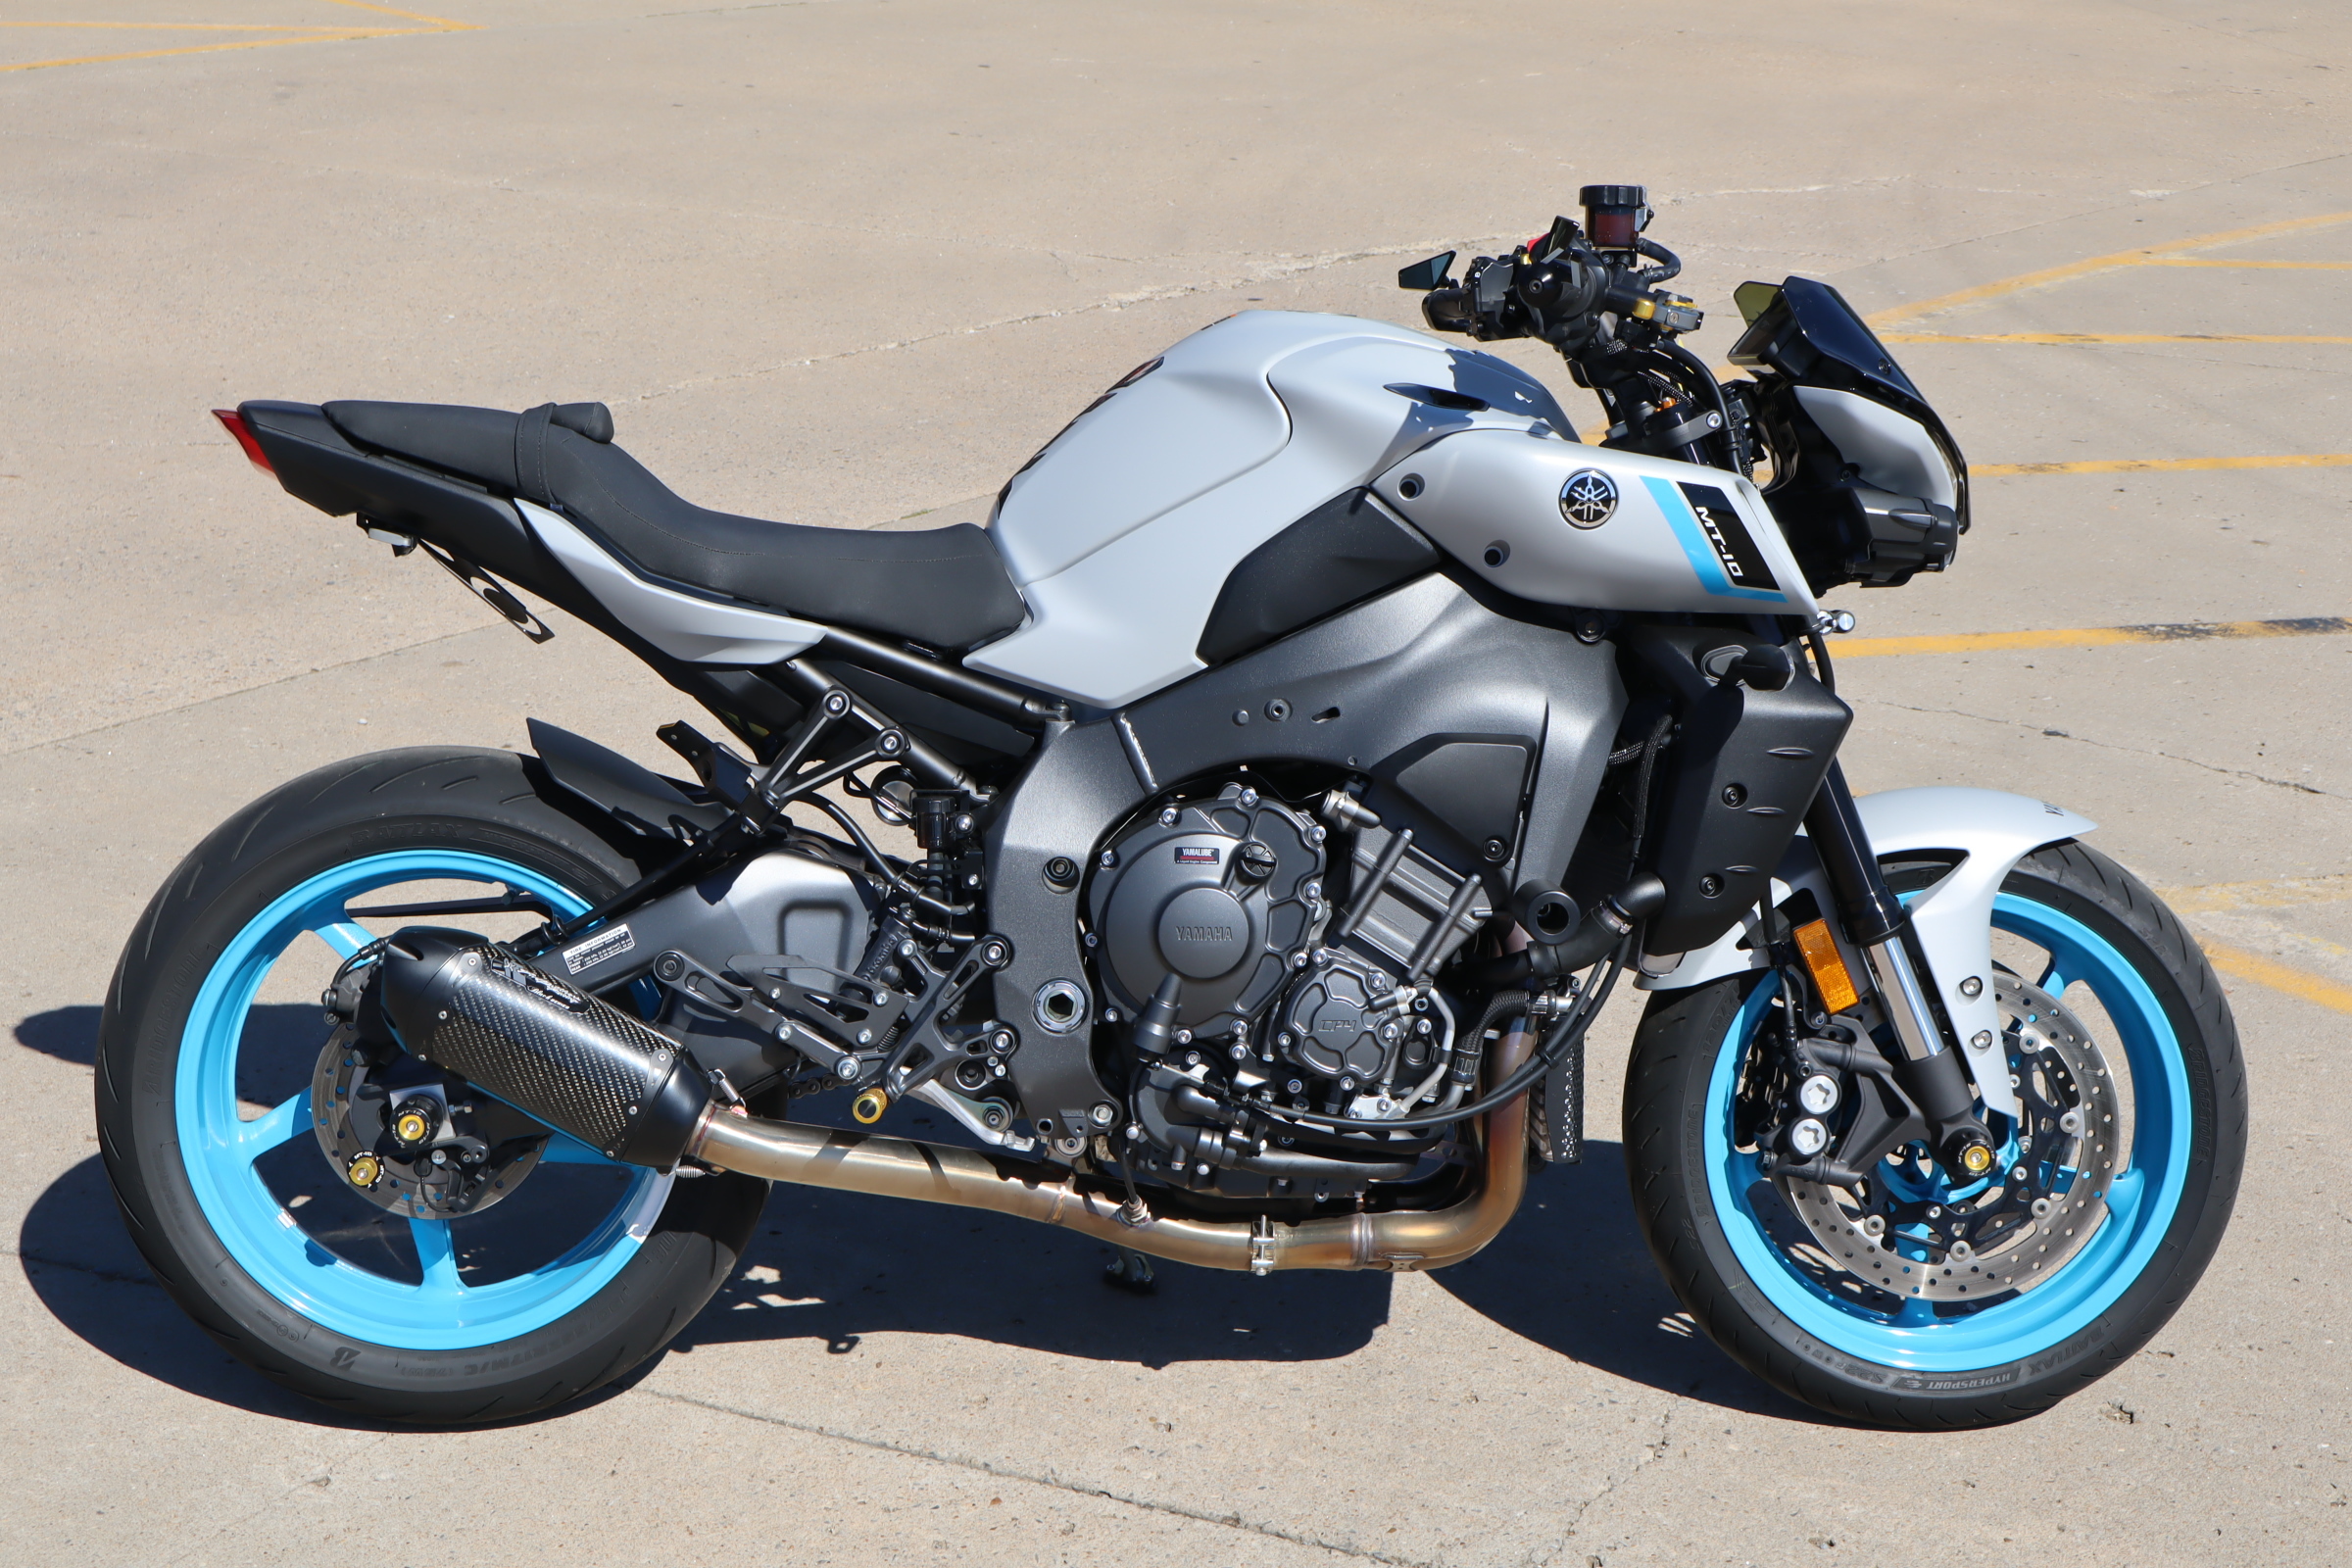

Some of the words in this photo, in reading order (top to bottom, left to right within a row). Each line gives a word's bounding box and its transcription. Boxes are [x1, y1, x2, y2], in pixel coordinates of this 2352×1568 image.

[1695, 507, 1743, 577] MT-10
[351, 822, 464, 847] BATTLAX
[1182, 848, 1213, 857] YAMALUBE
[1176, 926, 1233, 941] YAMAHA
[865, 936, 898, 974] brembo
[141, 946, 202, 1096] BRIDGESTONE
[1318, 1019, 1357, 1032] CP4
[2187, 1046, 2211, 1156] BRIDGESTONE
[354, 1151, 372, 1159] MT-10
[1687, 1108, 1708, 1217] BRIDGESTONE
[2029, 1325, 2105, 1377] BATTLAX
[1926, 1374, 2012, 1390] HYPERSPORT
